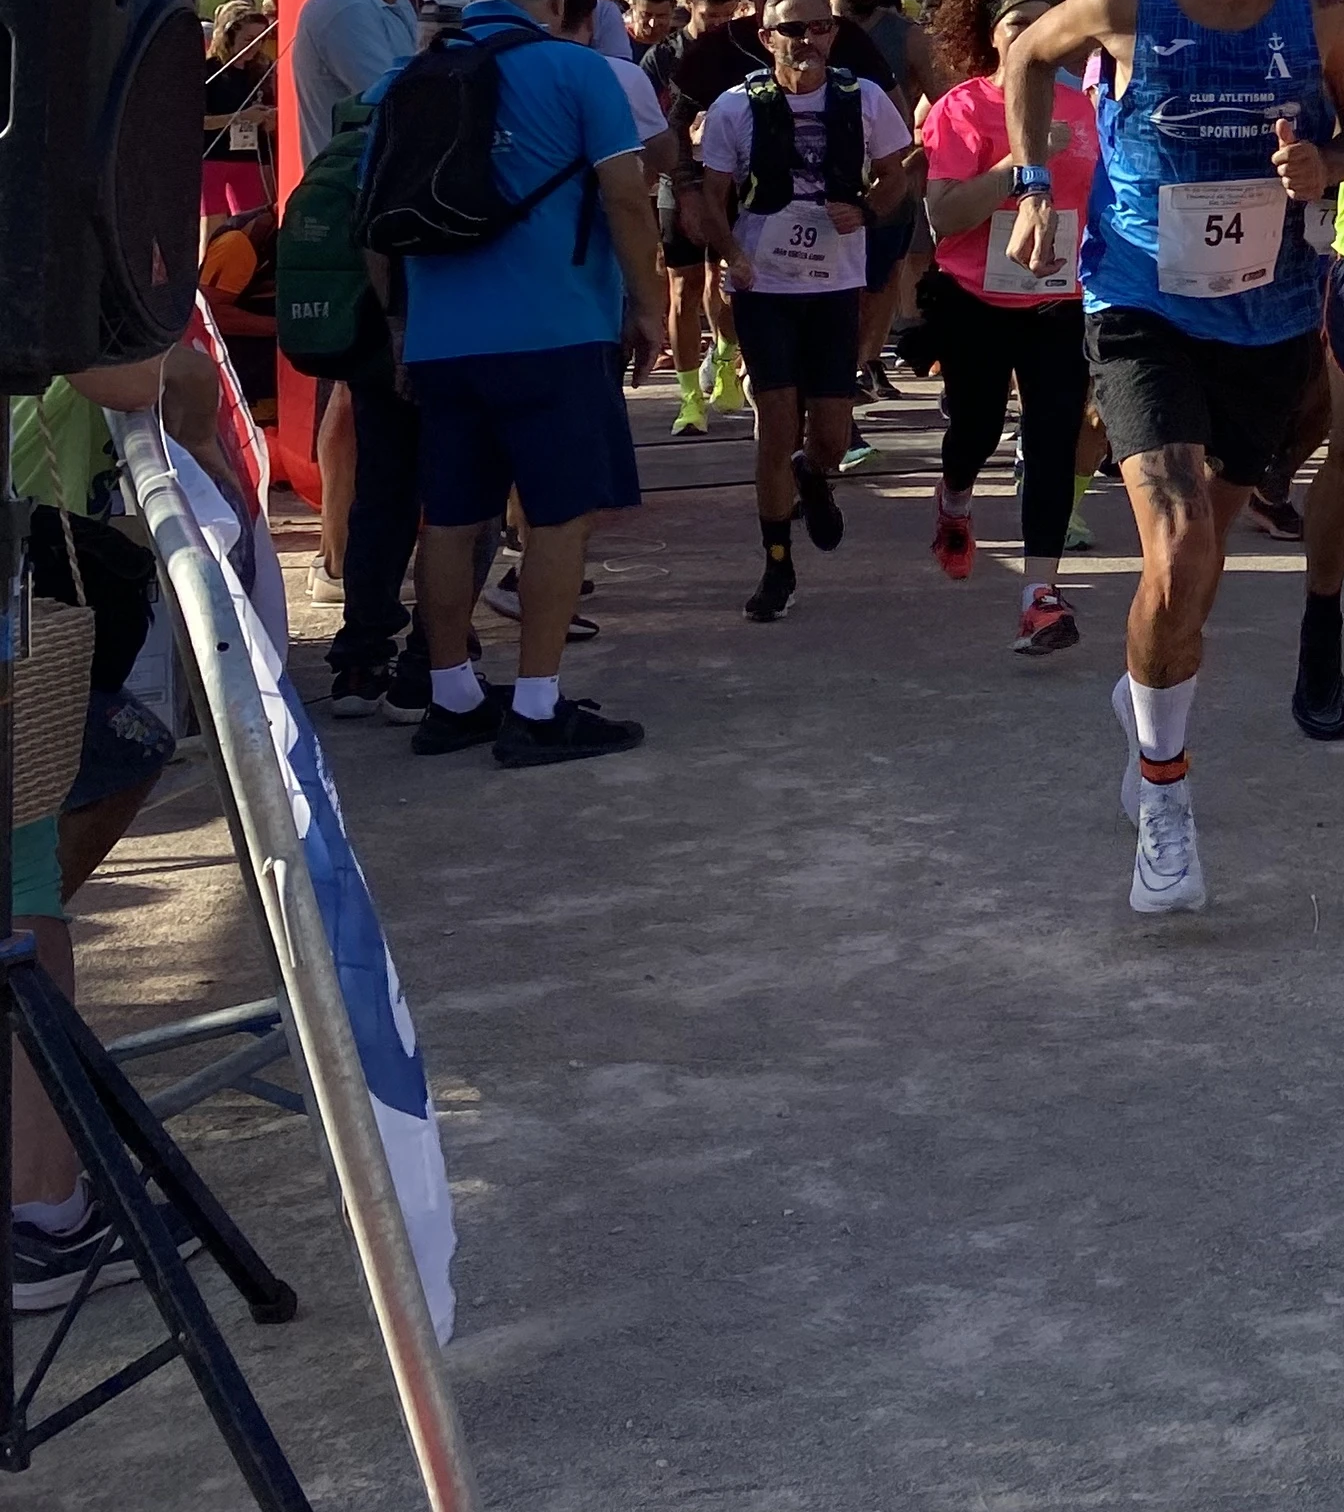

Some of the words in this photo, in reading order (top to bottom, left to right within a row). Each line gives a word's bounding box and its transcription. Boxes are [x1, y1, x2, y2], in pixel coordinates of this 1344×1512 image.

[1189, 92, 1215, 103] CLUB
[1218, 92, 1275, 103] ATLETISMO
[1200, 125, 1258, 138] SPORTING
[789, 224, 818, 248] 39
[1204, 212, 1244, 247] 54
